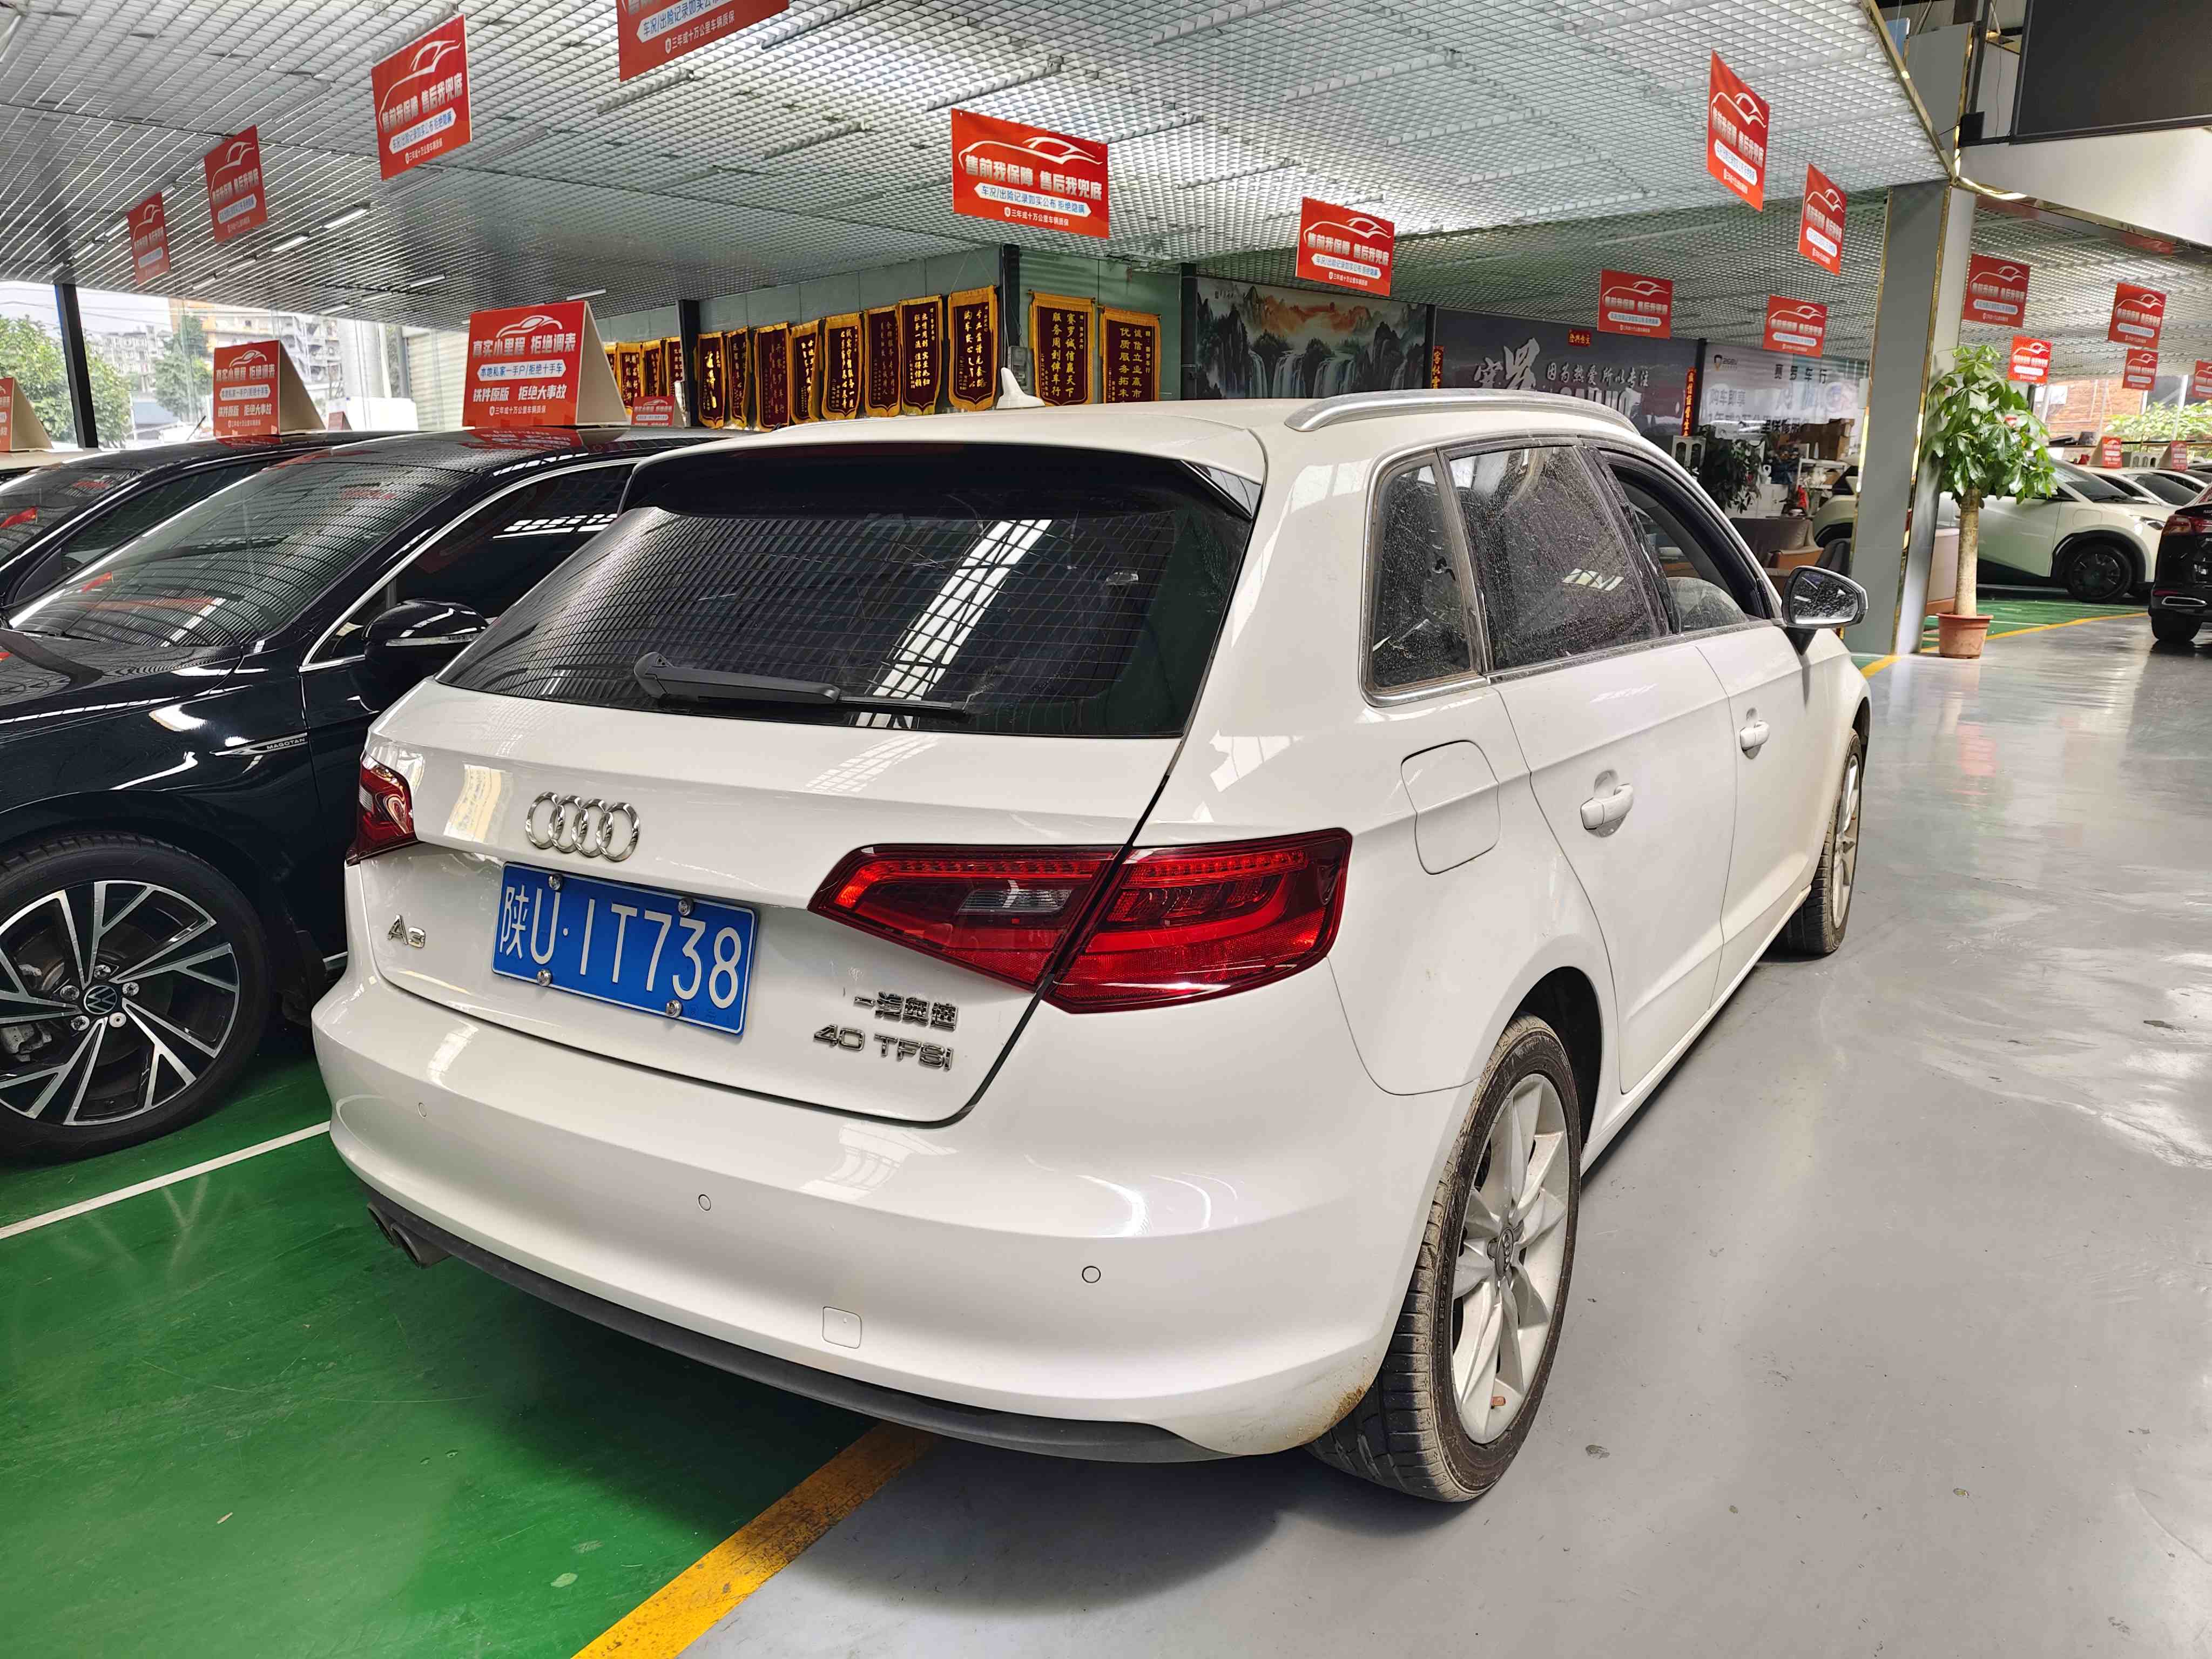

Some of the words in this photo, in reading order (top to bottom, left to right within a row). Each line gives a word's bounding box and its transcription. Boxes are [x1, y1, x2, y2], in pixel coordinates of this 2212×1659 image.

[672, 10, 735, 49] 三年或十万公里车辆质保
[965, 154, 1034, 187] 售前我保障
[1040, 170, 1102, 201] 售后我兜底
[981, 184, 1056, 208] 车况/出险记录如实公布
[1057, 199, 1085, 215] 拒绝隐瞒
[473, 336, 526, 359] 真实小里程
[530, 332, 576, 354] 拒绝调表
[1064, 313, 1077, 398] 赛罗诚信赢天下
[481, 362, 563, 378] 本地私家一手户/拒绝十手车
[1546, 362, 1650, 388] 因为热爱所以专注
[1774, 363, 1828, 384] 赛罗车行
[473, 387, 510, 402] 铁件原版
[517, 384, 568, 401] 拒绝大事故
[266, 737, 306, 751] MAGOTAN
[387, 914, 426, 949] A3
[813, 1024, 865, 1051] 40
[873, 1032, 954, 1072] TFSI
